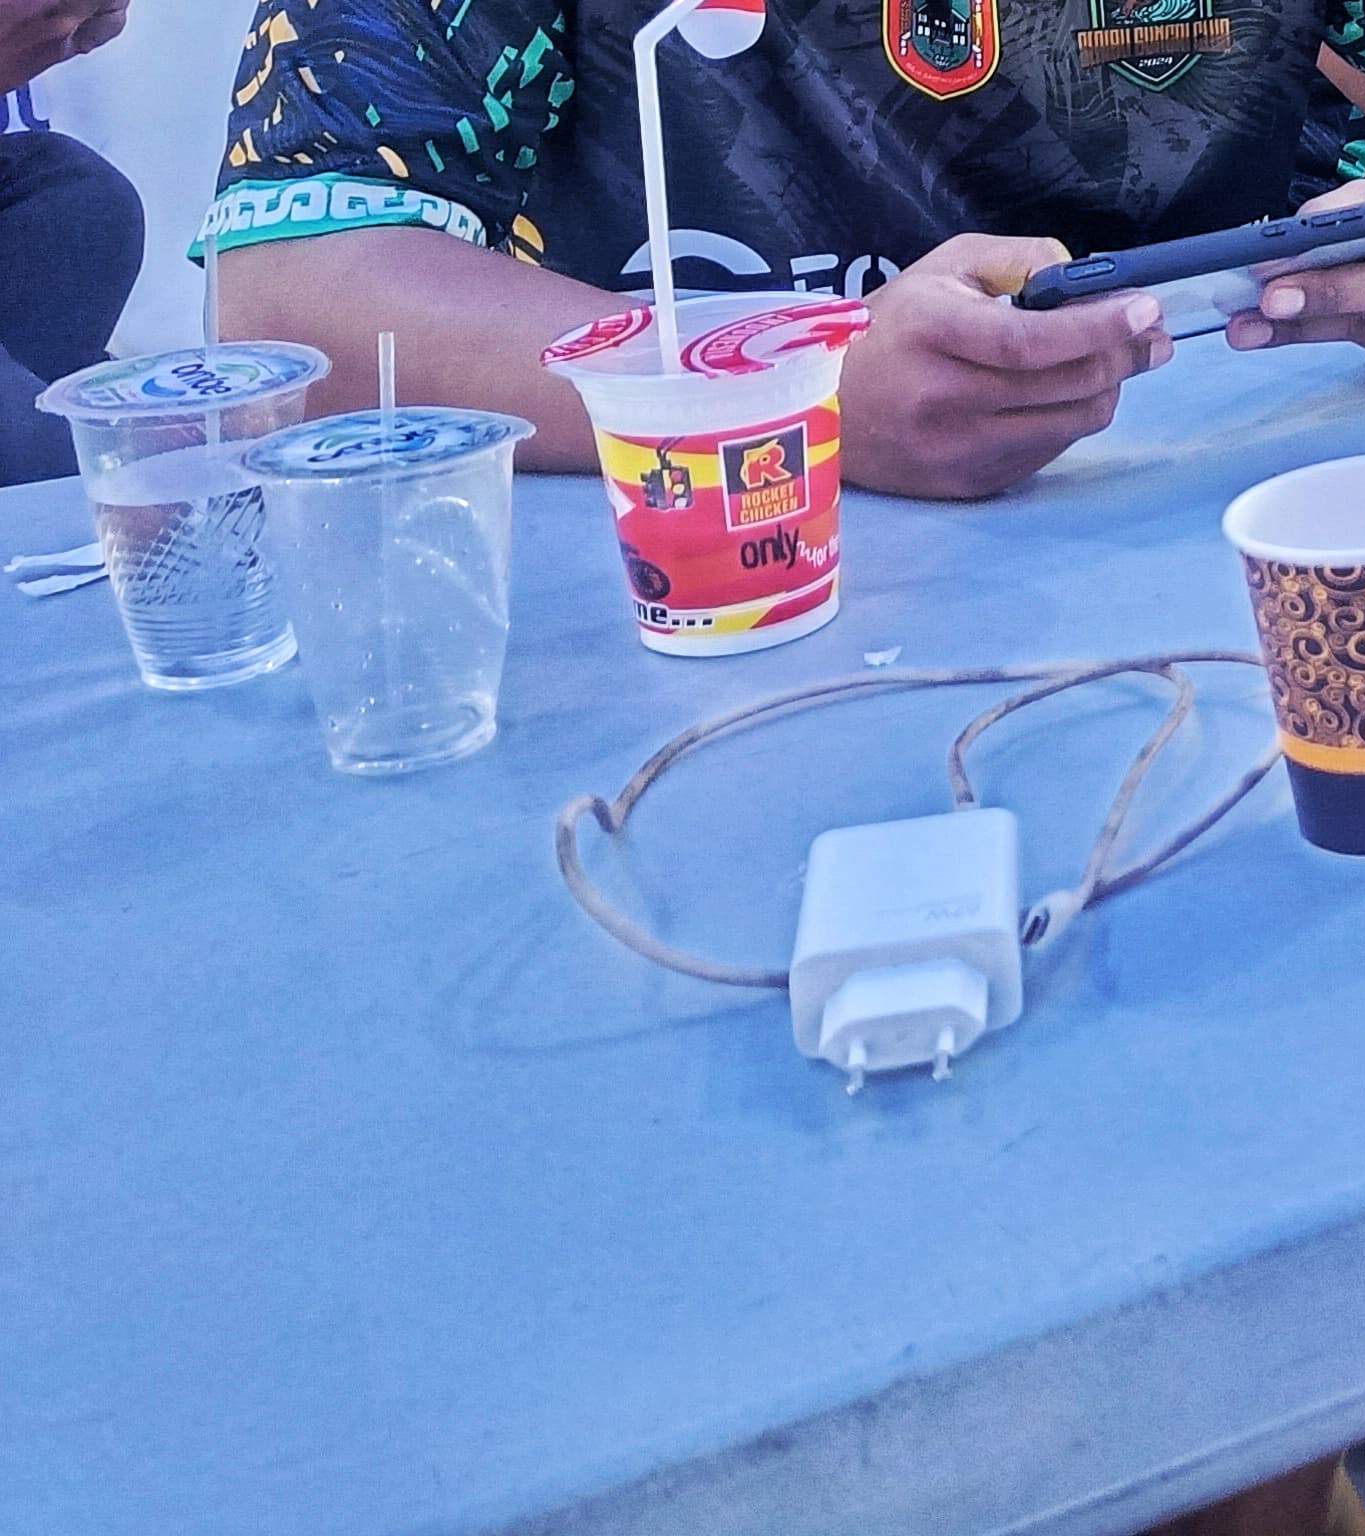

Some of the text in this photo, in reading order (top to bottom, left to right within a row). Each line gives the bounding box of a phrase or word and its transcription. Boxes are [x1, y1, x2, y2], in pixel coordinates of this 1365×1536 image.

[741, 481, 796, 510] ROCKET
[740, 496, 799, 525] CHICKEN
[740, 524, 800, 570] only
